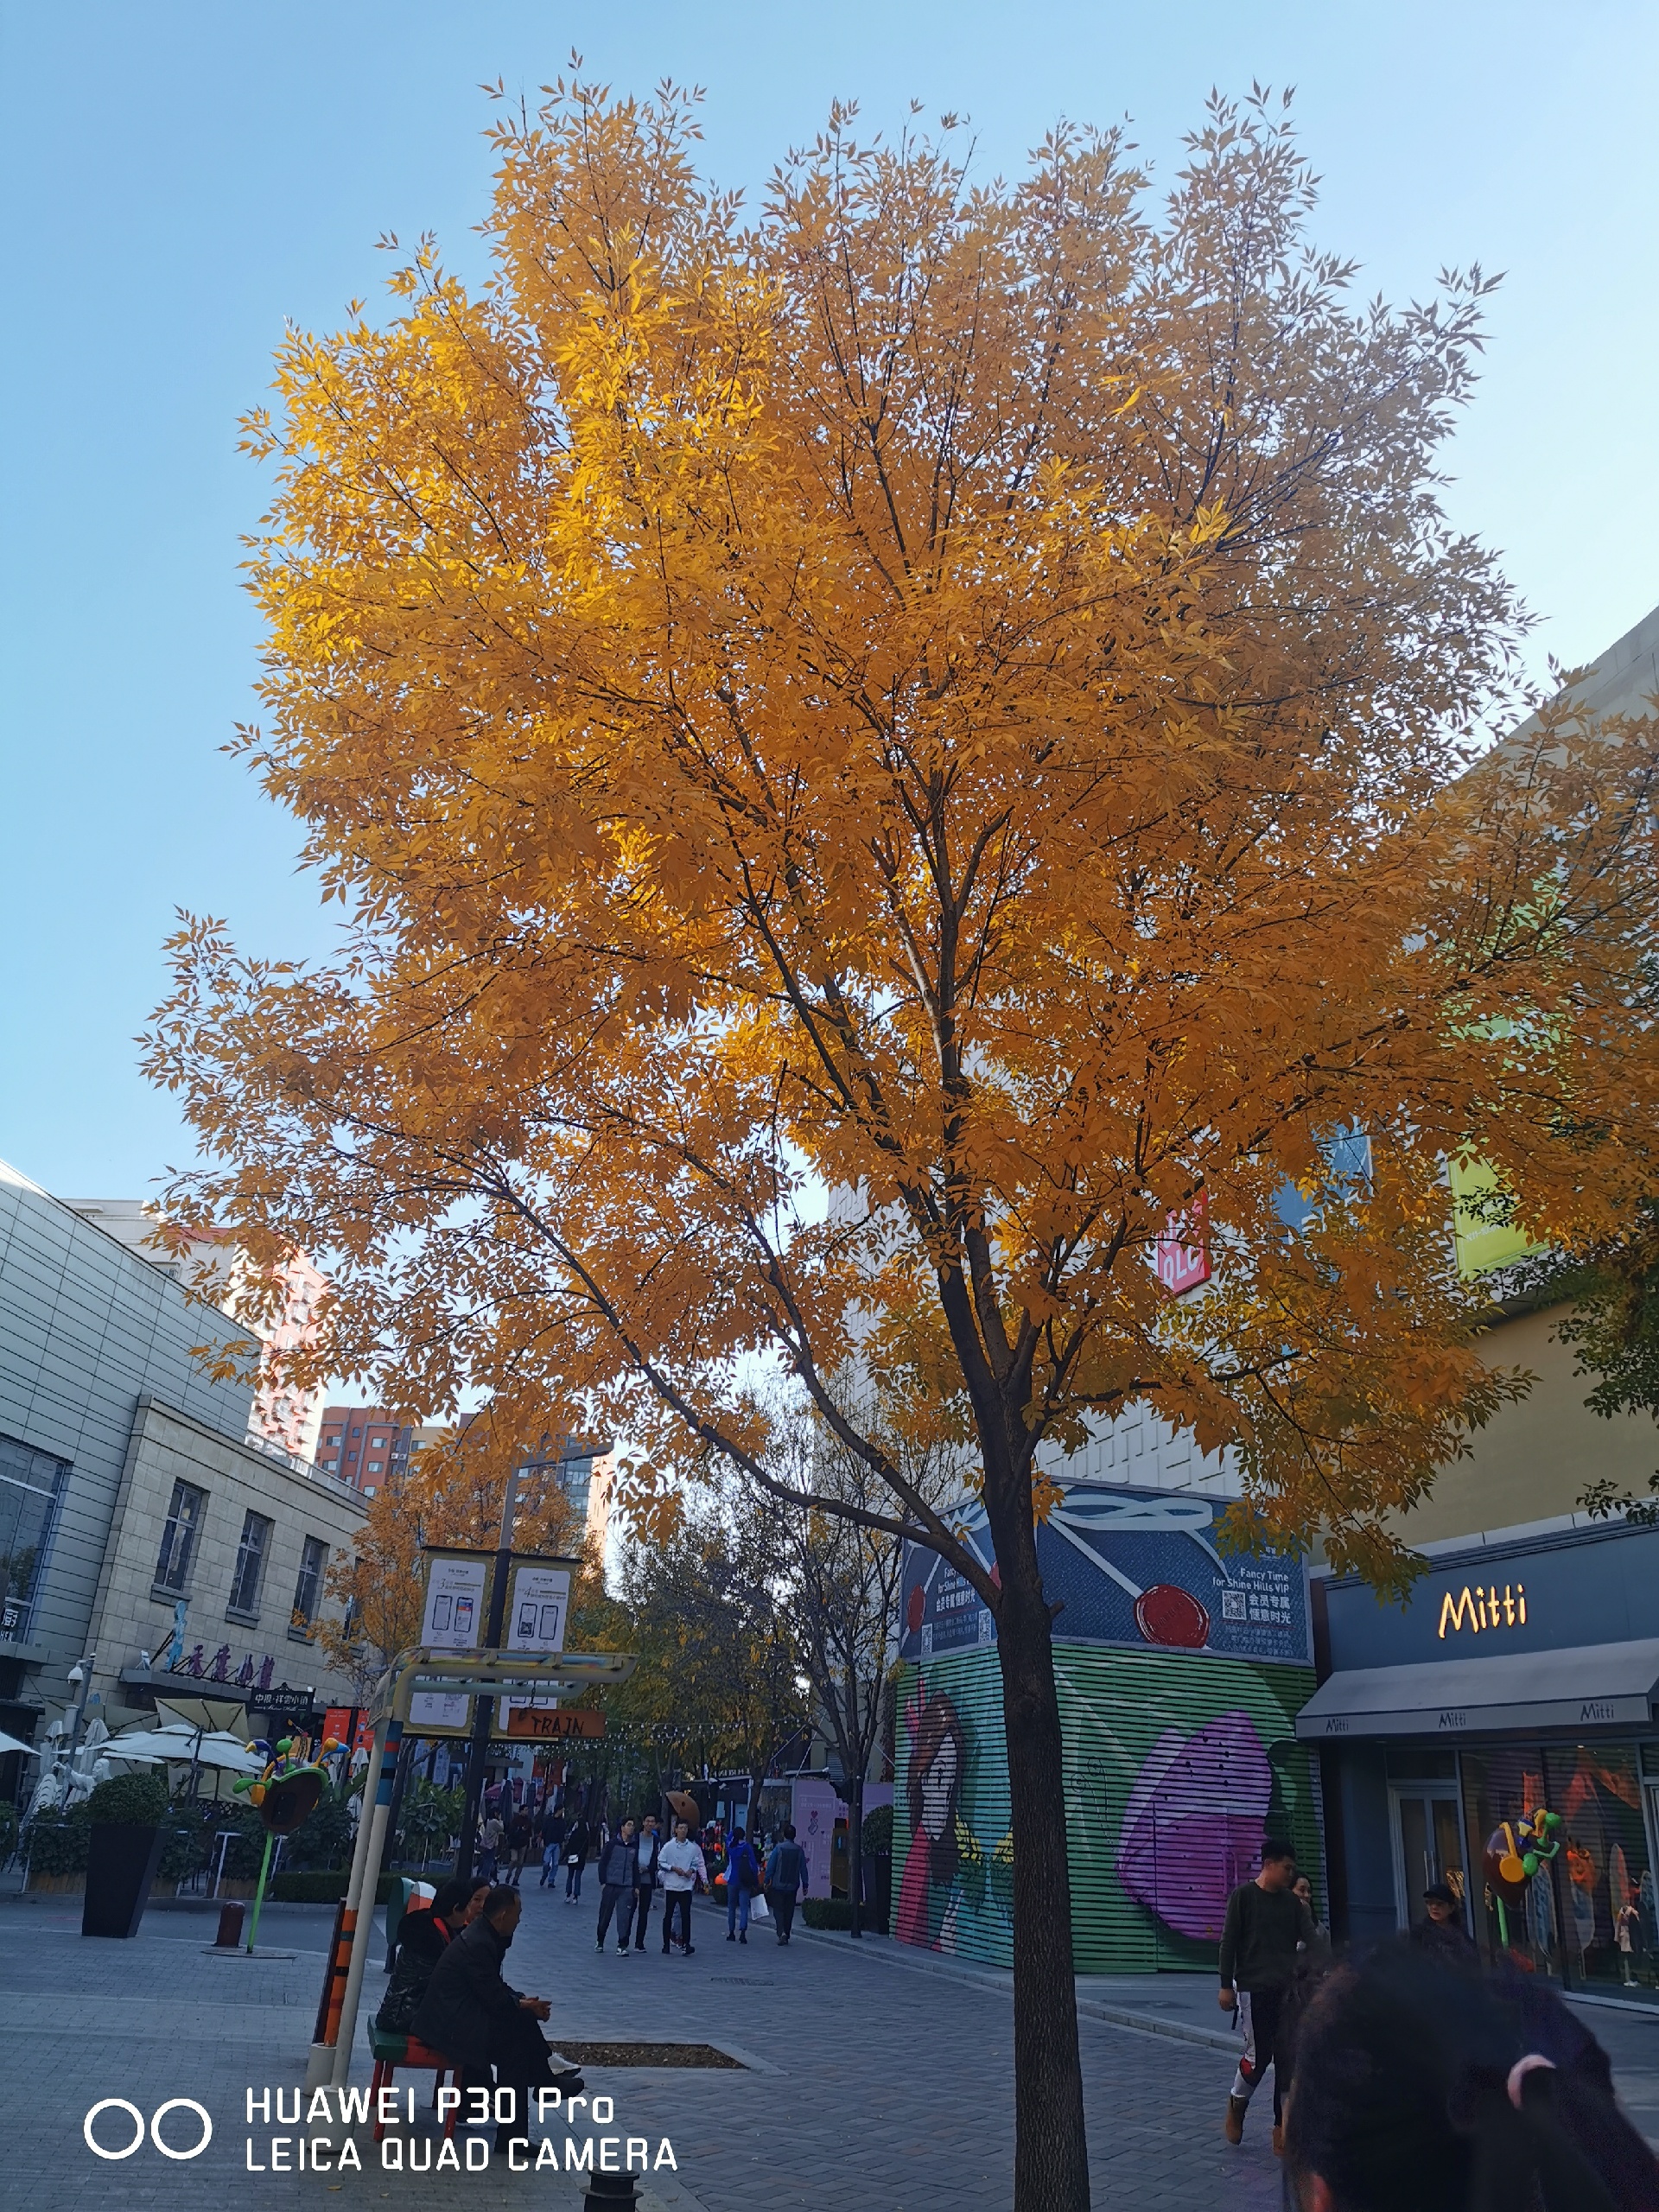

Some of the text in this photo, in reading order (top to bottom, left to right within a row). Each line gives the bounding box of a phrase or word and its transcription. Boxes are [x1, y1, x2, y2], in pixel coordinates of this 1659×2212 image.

[1240, 1567, 1289, 1582] Fancy Time
[1213, 1577, 1289, 1593] for Shine Hills VIP
[1249, 1594, 1291, 1610] 会员专属
[1439, 1583, 1527, 1639] Mitti
[1580, 1703, 1614, 1722] Mitti
[531, 1716, 585, 1735] TRAIN
[1325, 1718, 1349, 1733] Mitti
[1438, 1713, 1466, 1729] Mitti
